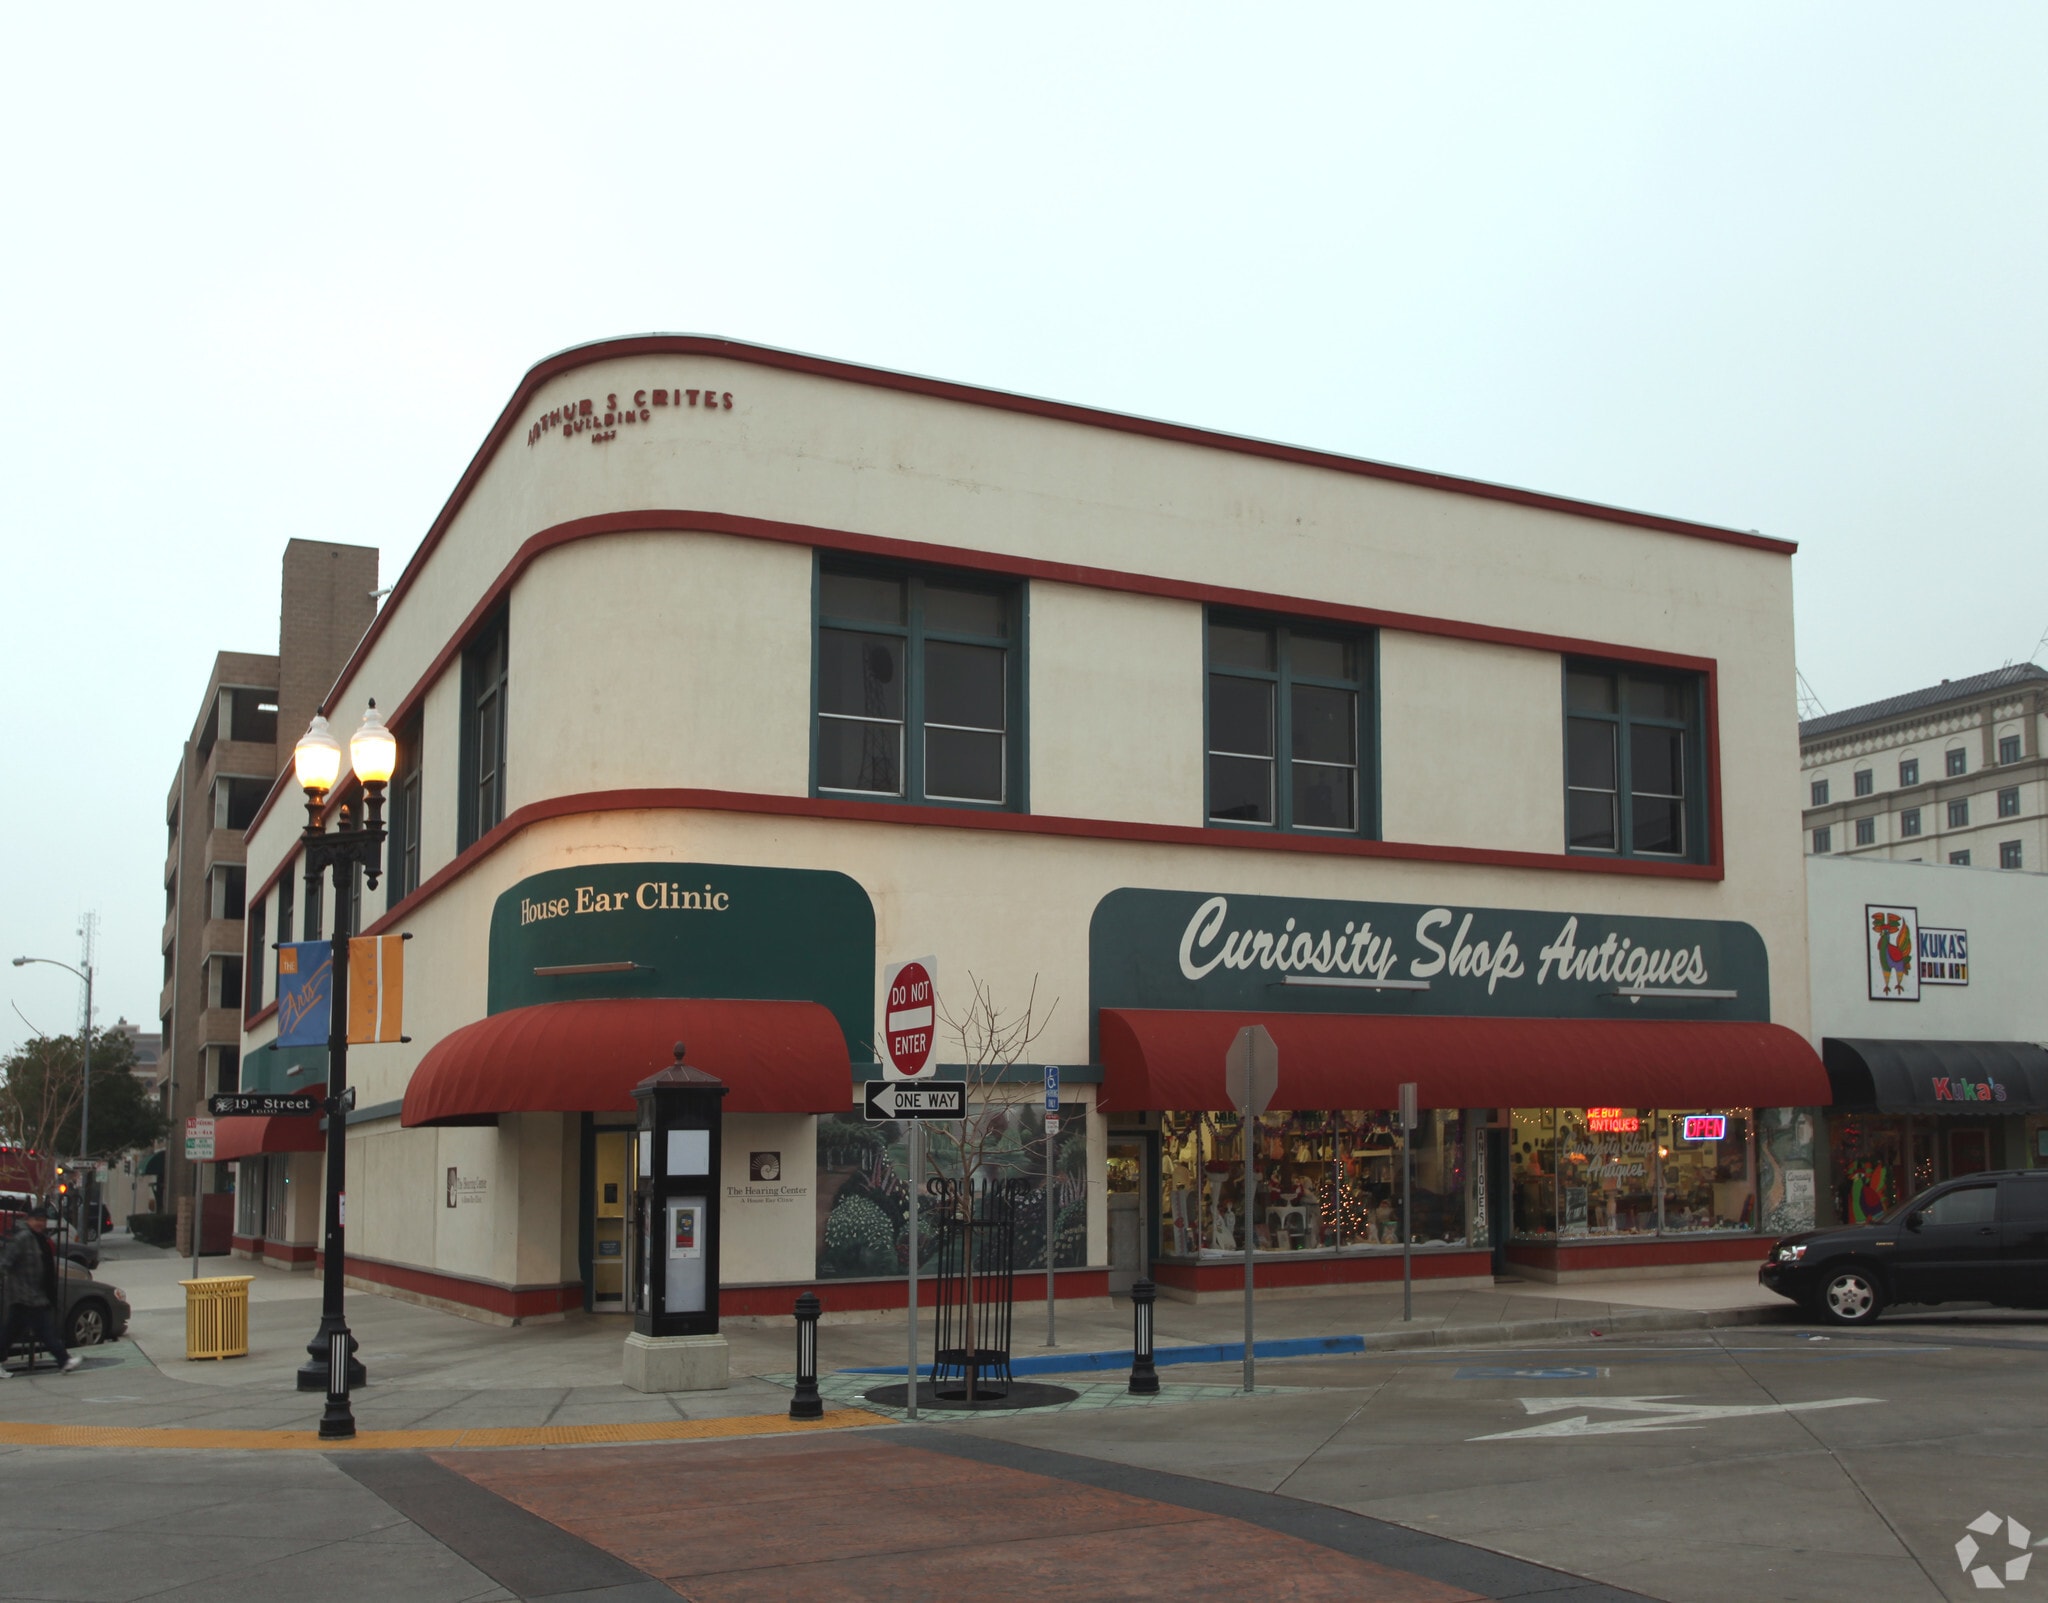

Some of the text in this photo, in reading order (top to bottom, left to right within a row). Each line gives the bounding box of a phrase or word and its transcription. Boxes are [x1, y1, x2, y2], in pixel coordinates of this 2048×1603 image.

[527, 389, 734, 448] ARTHUR S CRITES
[563, 409, 651, 437] BUILDING
[521, 882, 730, 926] House Ear Clinic
[1178, 896, 1709, 1003] Curiosity Shop Antiques
[1920, 933, 1966, 959] KUKA'S
[284, 961, 295, 971] THE
[1921, 962, 1967, 979] FOLK ART
[892, 981, 930, 1006] DO NOT
[895, 1033, 926, 1055] ENTER
[895, 1093, 956, 1108] ONE WAY
[1932, 1077, 2007, 1102] Kuka's
[264, 1098, 311, 1109] Street
[1587, 1108, 1621, 1118] WE BUY
[1590, 1119, 1639, 1131] ANTIQUES
[1686, 1118, 1723, 1137] OPEN
[1622, 1132, 1654, 1158] Shop
[1586, 1154, 1647, 1187] Antiques
[727, 1185, 808, 1197] The Hearing Center
